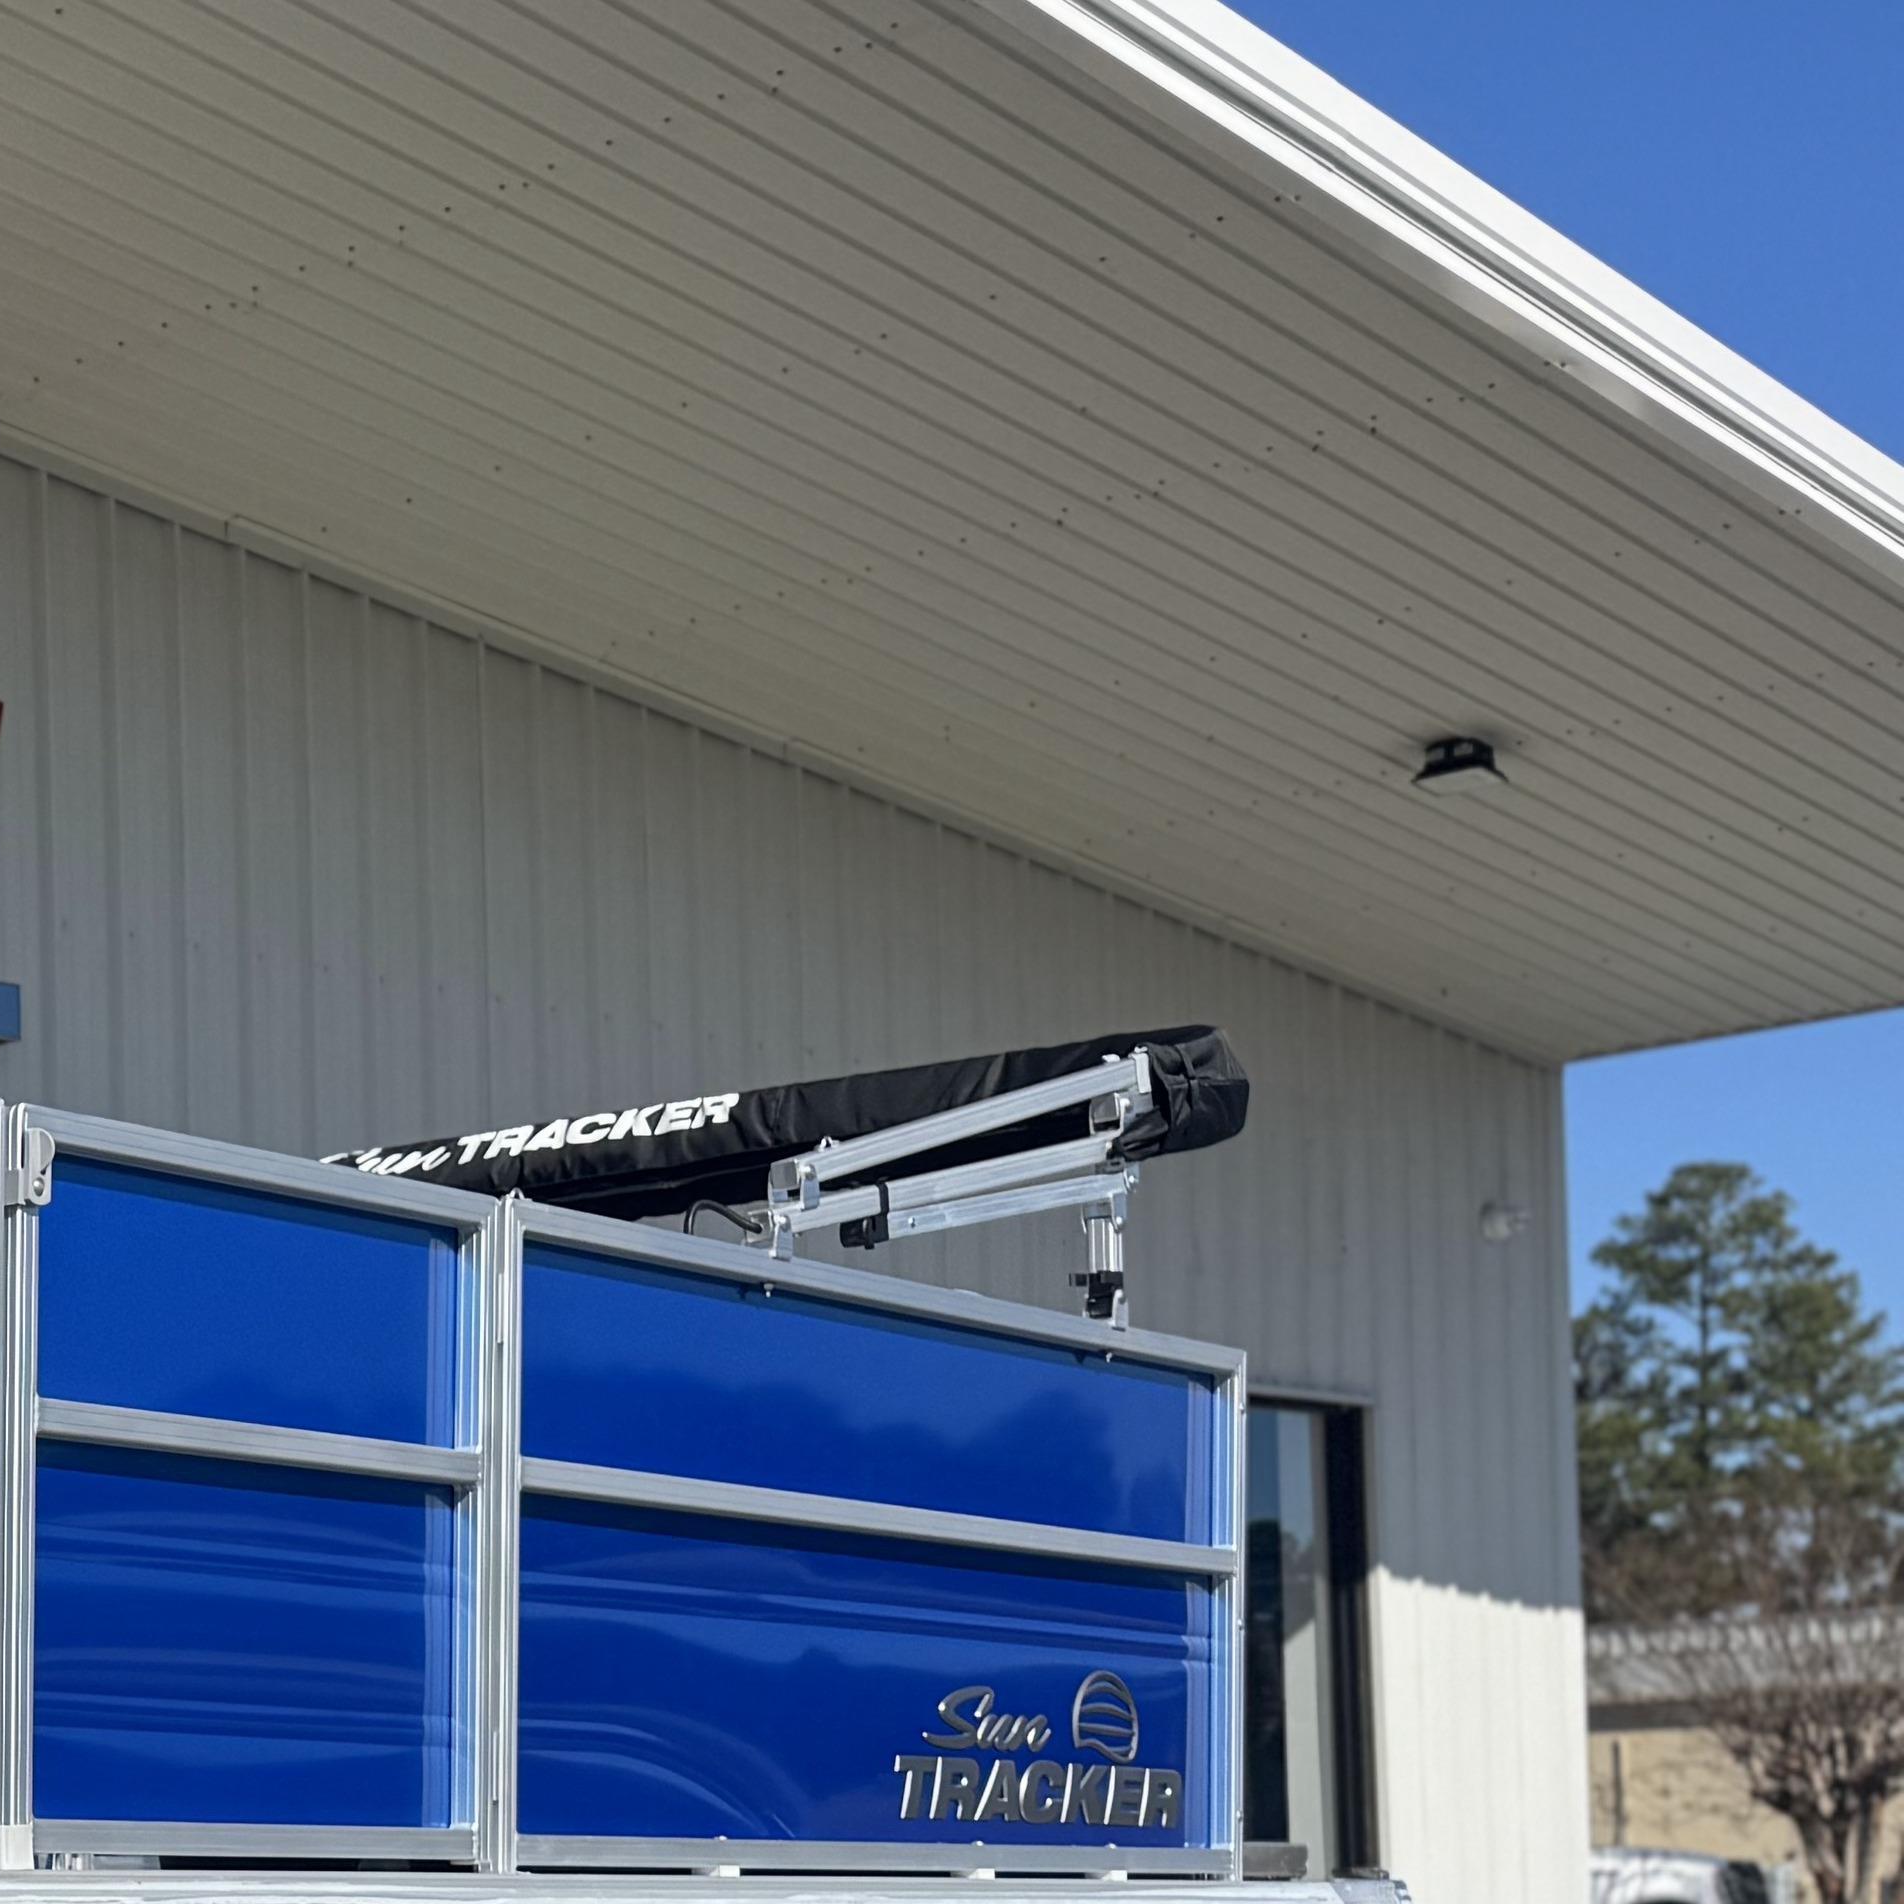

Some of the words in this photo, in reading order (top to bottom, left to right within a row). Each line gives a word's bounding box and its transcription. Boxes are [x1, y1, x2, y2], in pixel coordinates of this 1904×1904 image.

[456, 1092, 740, 1165] TRACKER
[921, 1685, 1052, 1752] Sun
[893, 1754, 1183, 1829] TRACKER
